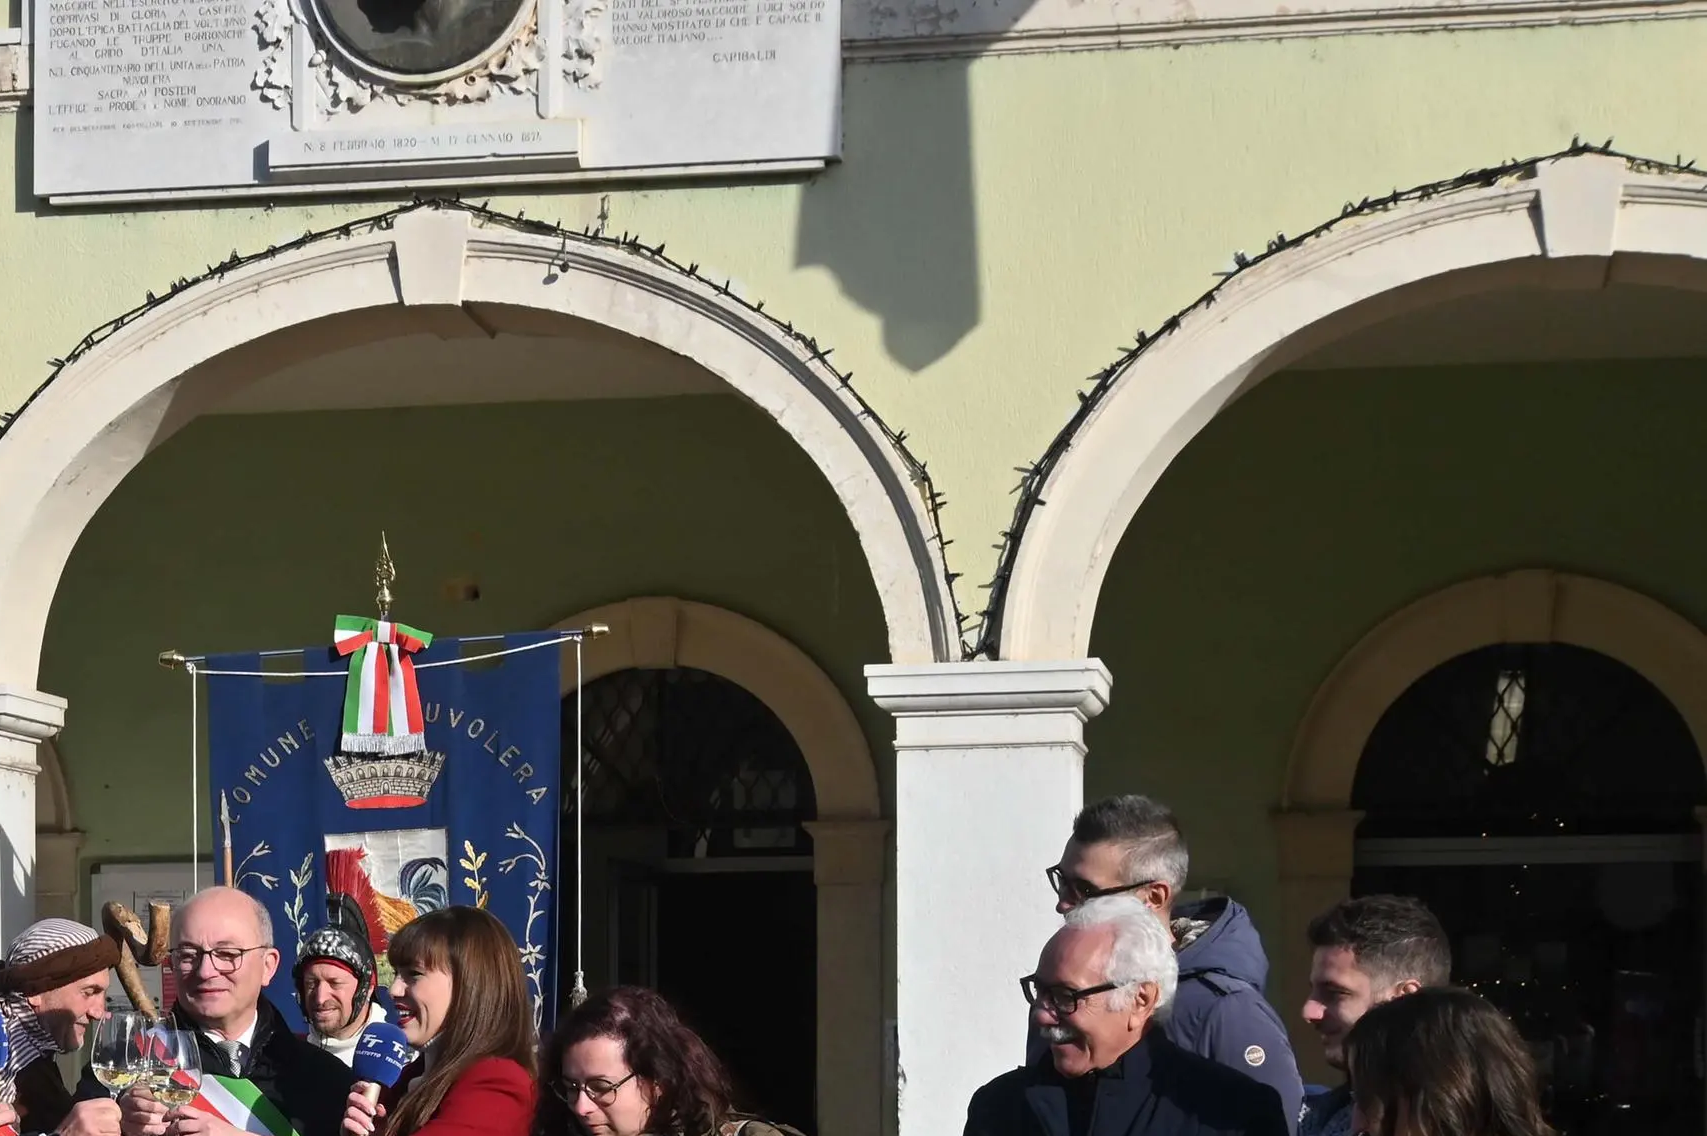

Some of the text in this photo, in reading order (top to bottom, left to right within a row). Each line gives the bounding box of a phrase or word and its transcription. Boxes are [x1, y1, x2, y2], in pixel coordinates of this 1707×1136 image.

[110, 12, 119, 22] DI
[179, 9, 186, 17] A
[49, 27, 76, 38] DOPO
[173, 20, 190, 30] DEL
[712, 50, 776, 62] GARIBALDI
[213, 57, 246, 69] PATRIA
[122, 74, 172, 85] NUVOLERA
[393, 137, 417, 148] 1820
